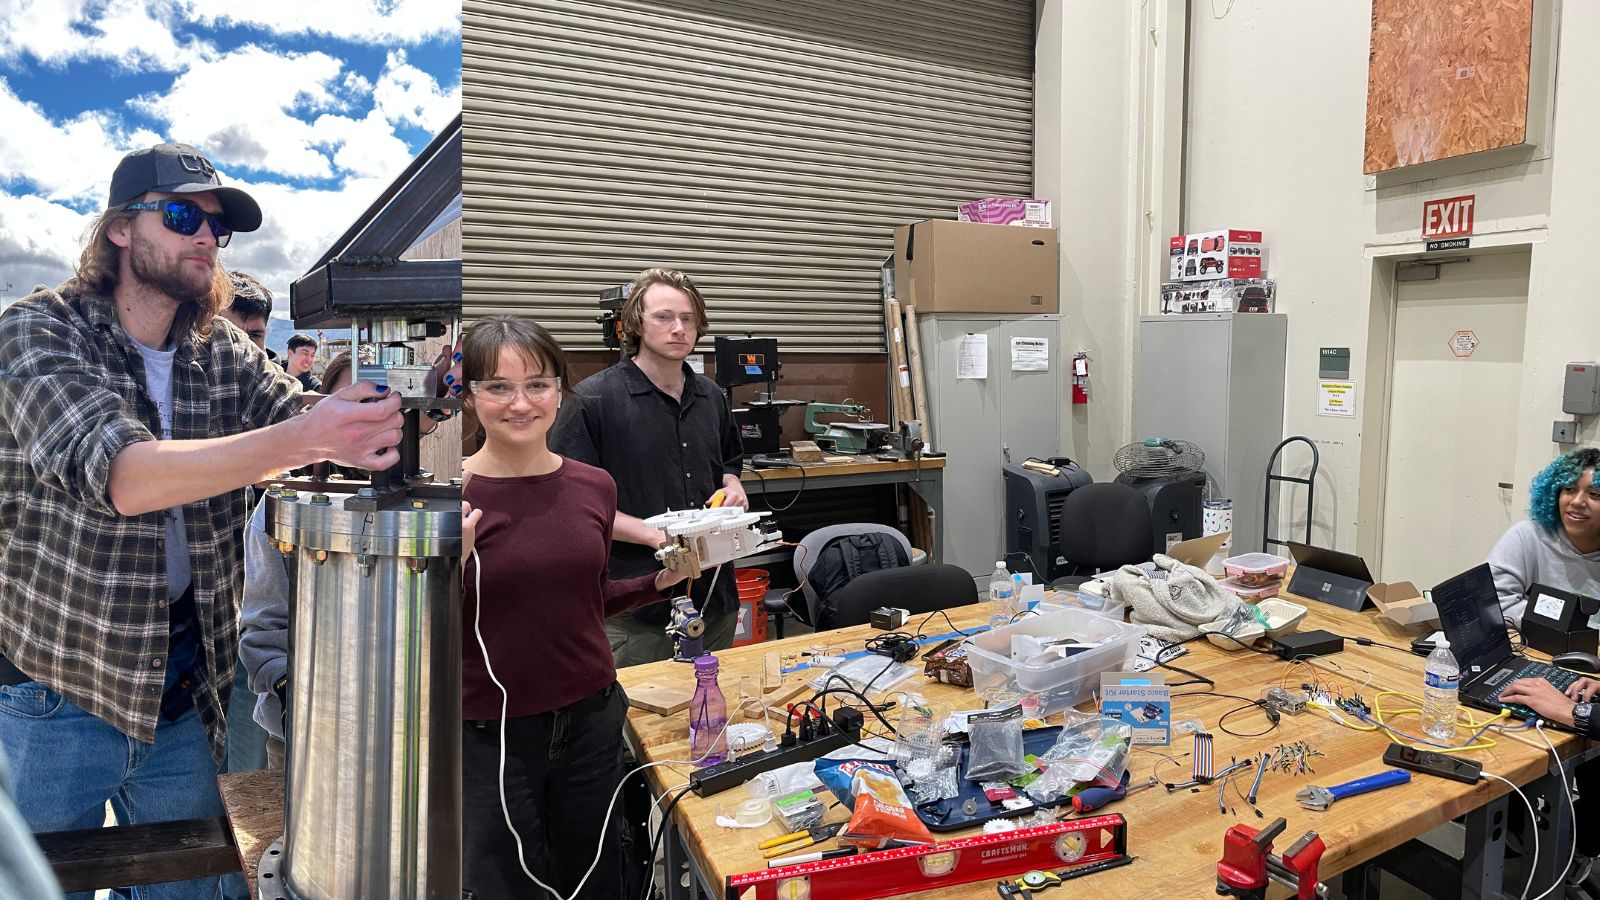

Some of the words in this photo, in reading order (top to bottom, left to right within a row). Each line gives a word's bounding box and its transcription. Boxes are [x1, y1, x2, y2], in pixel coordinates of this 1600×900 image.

[1425, 199, 1473, 235] EXIT
[1440, 240, 1467, 248] SMOKING
[1105, 689, 1117, 697] Kit
[1118, 689, 1146, 697] Starter
[1147, 689, 1169, 697] Basic
[981, 844, 1028, 858] CRAFTSMAN
